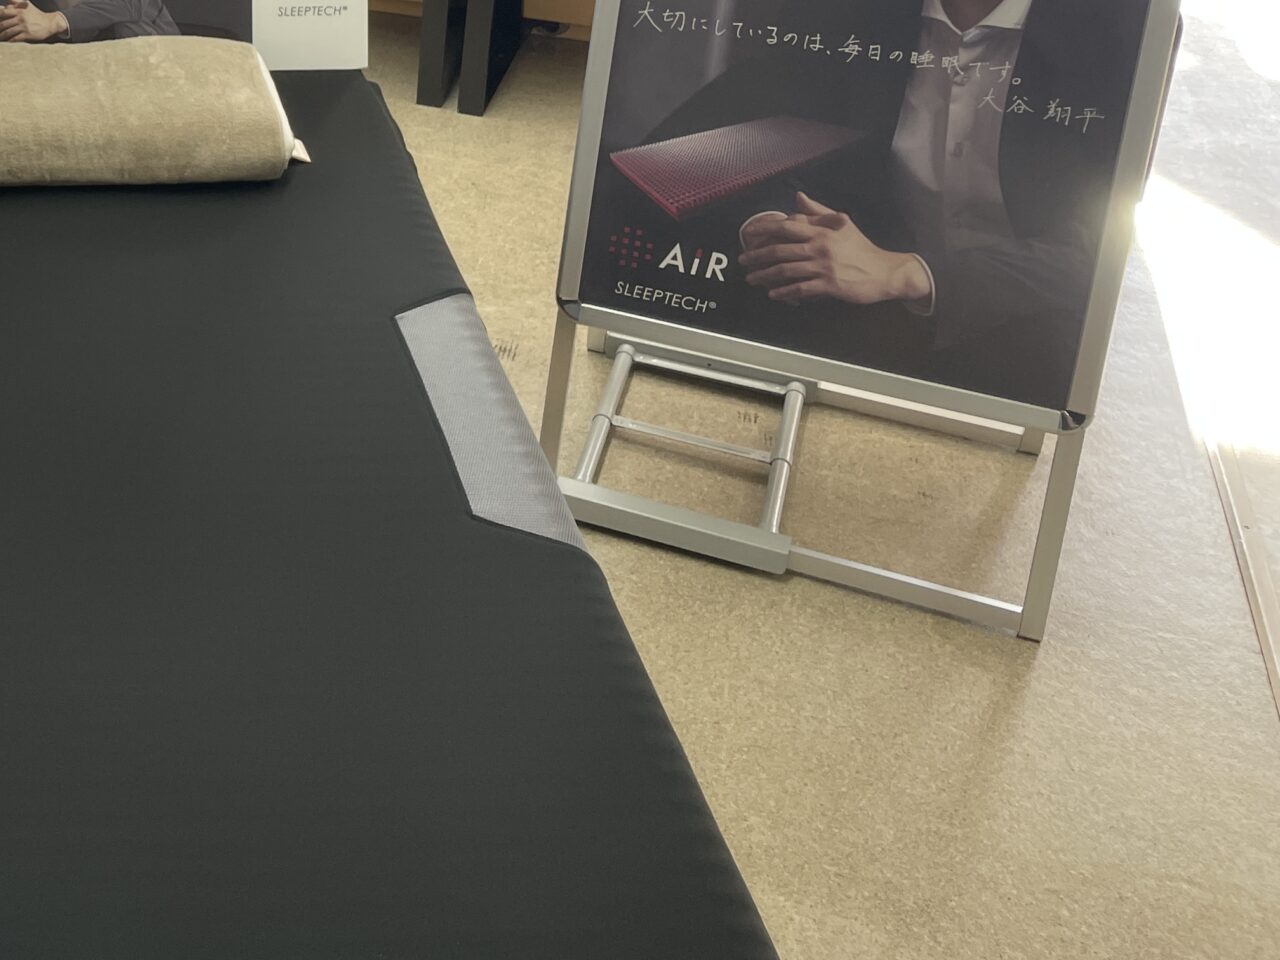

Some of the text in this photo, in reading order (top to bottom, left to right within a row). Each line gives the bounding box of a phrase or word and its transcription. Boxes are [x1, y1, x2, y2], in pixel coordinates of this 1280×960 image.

[633, 0, 1022, 86] 大切にしているのは、毎日の睡眠です。
[658, 242, 729, 282] AiR
